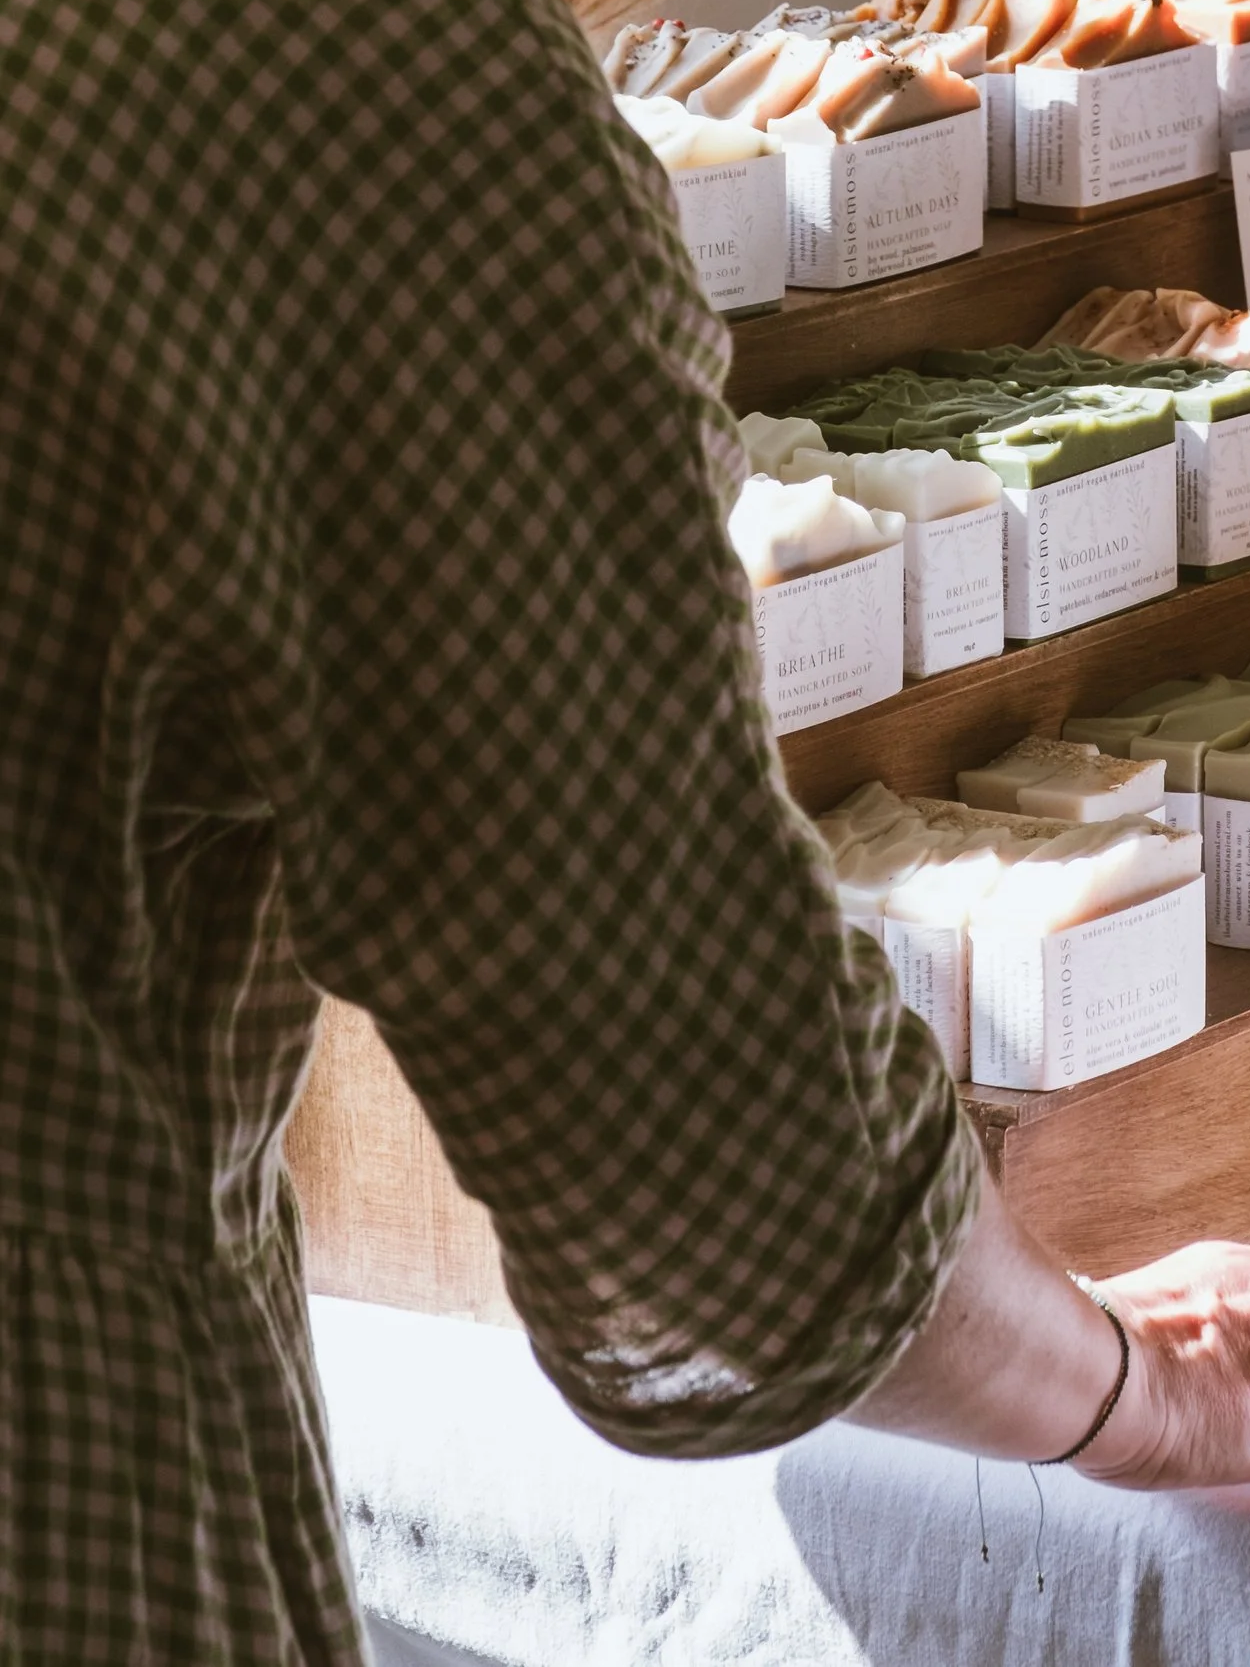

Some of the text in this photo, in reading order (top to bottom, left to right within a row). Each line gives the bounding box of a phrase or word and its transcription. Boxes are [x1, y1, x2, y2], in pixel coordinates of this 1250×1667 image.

[1088, 77, 1101, 198] elsie moss
[1109, 115, 1204, 152] INDIAN SUMMER
[705, 167, 747, 184] earthkind
[844, 153, 858, 278] elsie moss
[865, 193, 960, 229] AUTUMN DAYS
[716, 265, 741, 279] SOAP
[711, 285, 744, 299] rosemary
[1056, 459, 1146, 497] natural vegan earthkind
[1036, 493, 1050, 624] elsie moss
[1058, 534, 1130, 572] WOODLAND
[777, 559, 878, 600] natural vegan earthkind
[945, 575, 990, 602] BREATHE
[1059, 558, 1142, 596] HANDCRAFTED SOAP
[1131, 574, 1154, 589] vetiver
[1154, 570, 1161, 581] &
[926, 596, 985, 622] HANDCRAFTED
[777, 643, 846, 678] BREATHE
[778, 662, 874, 702] HANDCRAFTED SOAP
[778, 684, 864, 722] eucalyptus & rosemary
[1081, 896, 1181, 941] natural vegan earthkind
[1059, 938, 1075, 1076] elsie moss
[1085, 971, 1180, 1020] GENTLE SOUL
[1085, 993, 1178, 1037] HANDCRAFTED SOAP
